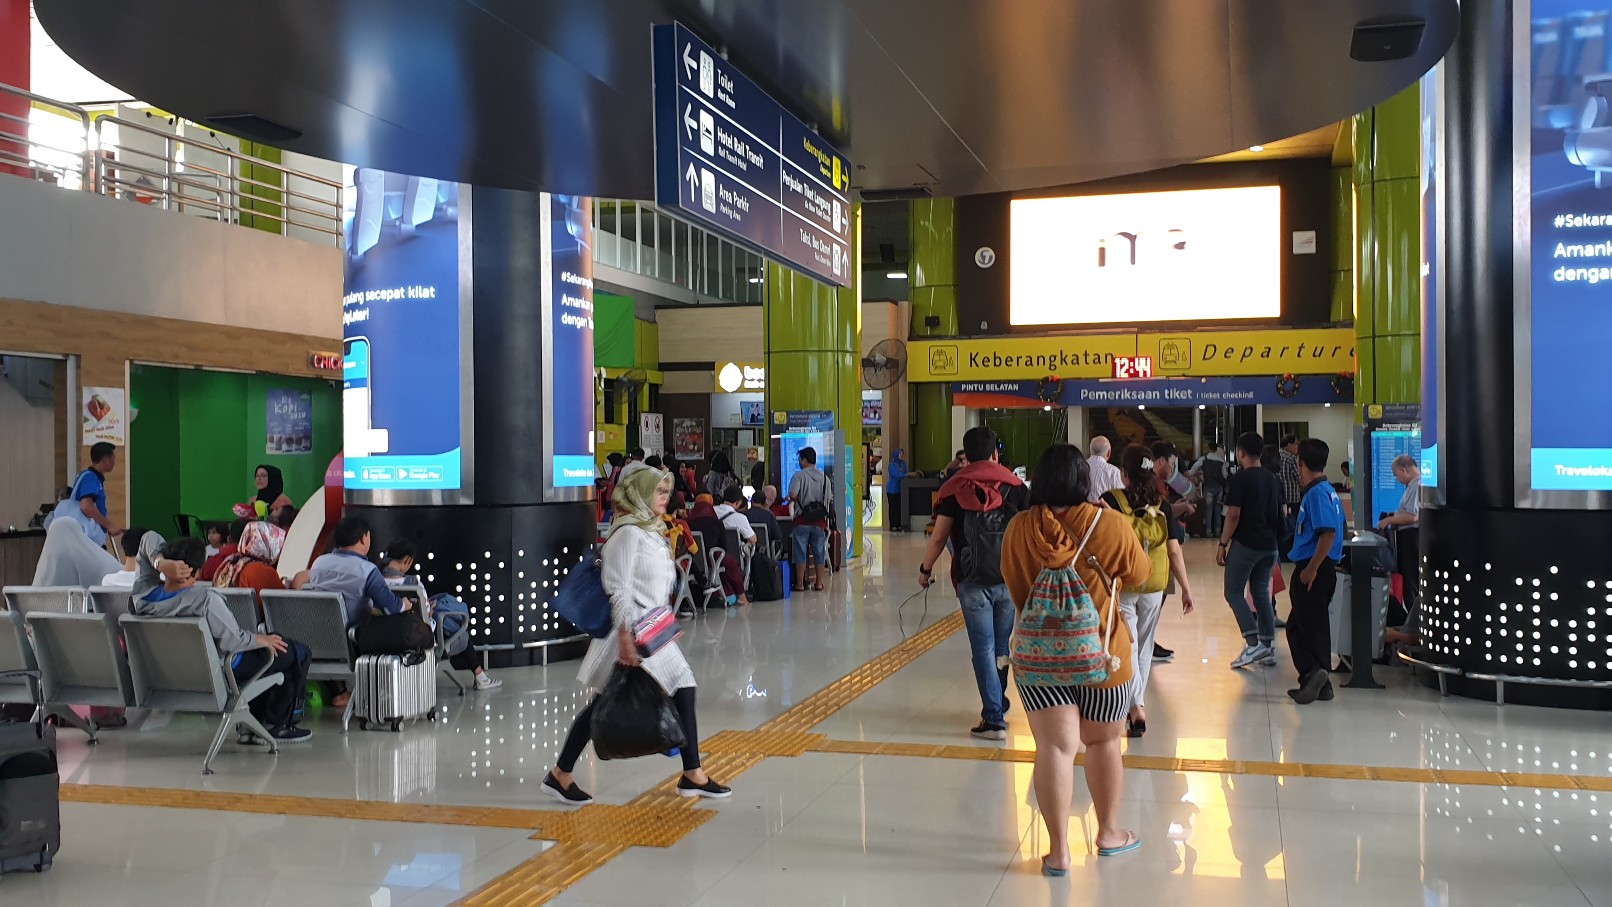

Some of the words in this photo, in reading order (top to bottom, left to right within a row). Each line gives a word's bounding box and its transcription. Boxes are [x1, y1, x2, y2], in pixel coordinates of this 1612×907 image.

[717, 69, 734, 95] Toilet
[717, 126, 733, 146] Hotel
[734, 136, 745, 154] Rail
[745, 144, 764, 170] Transit
[783, 170, 804, 195] Penjualan
[804, 183, 814, 201] Tiket
[719, 183, 732, 202] Area
[733, 190, 750, 213] Parkir
[1553, 265, 1612, 284] denga
[365, 286, 405, 303] secepat
[408, 285, 436, 299] kilat
[561, 312, 587, 329] dengan
[969, 349, 1114, 371] Keberangkatan
[1114, 356, 1152, 378] 12:44
[961, 383, 984, 392] PINTU
[1080, 388, 1160, 401] Pemeriksaan
[1164, 387, 1193, 400] tiket
